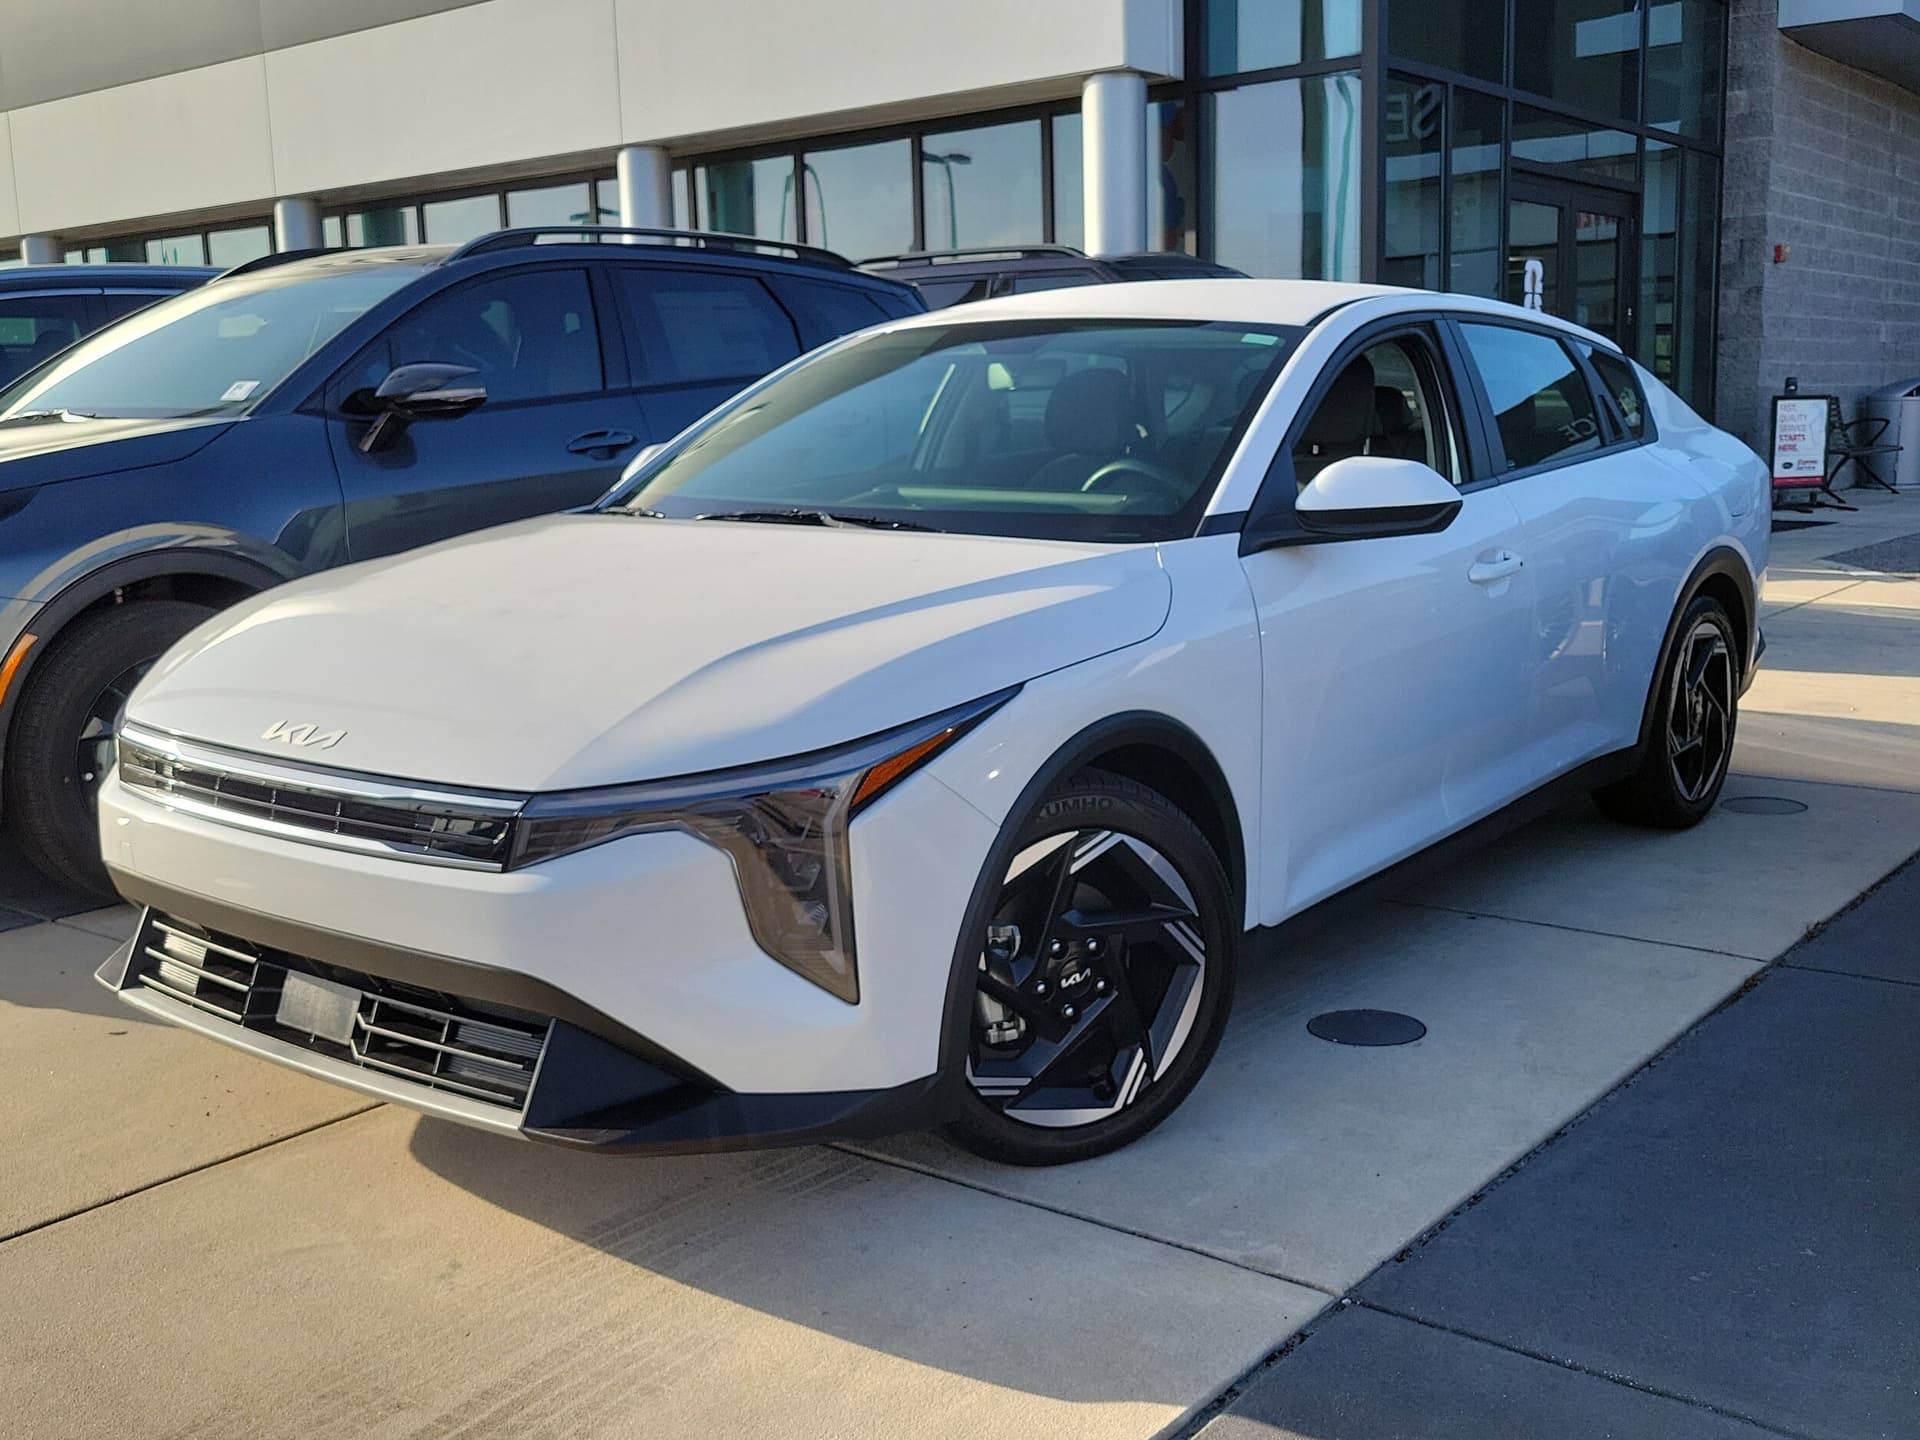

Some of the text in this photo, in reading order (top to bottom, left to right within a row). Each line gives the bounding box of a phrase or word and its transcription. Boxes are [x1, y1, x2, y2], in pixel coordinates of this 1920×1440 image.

[1779, 414, 1807, 423] QUALITY
[1779, 424, 1807, 432] SERVICE
[261, 719, 348, 750] KIA
[1060, 967, 1091, 988] KIA
